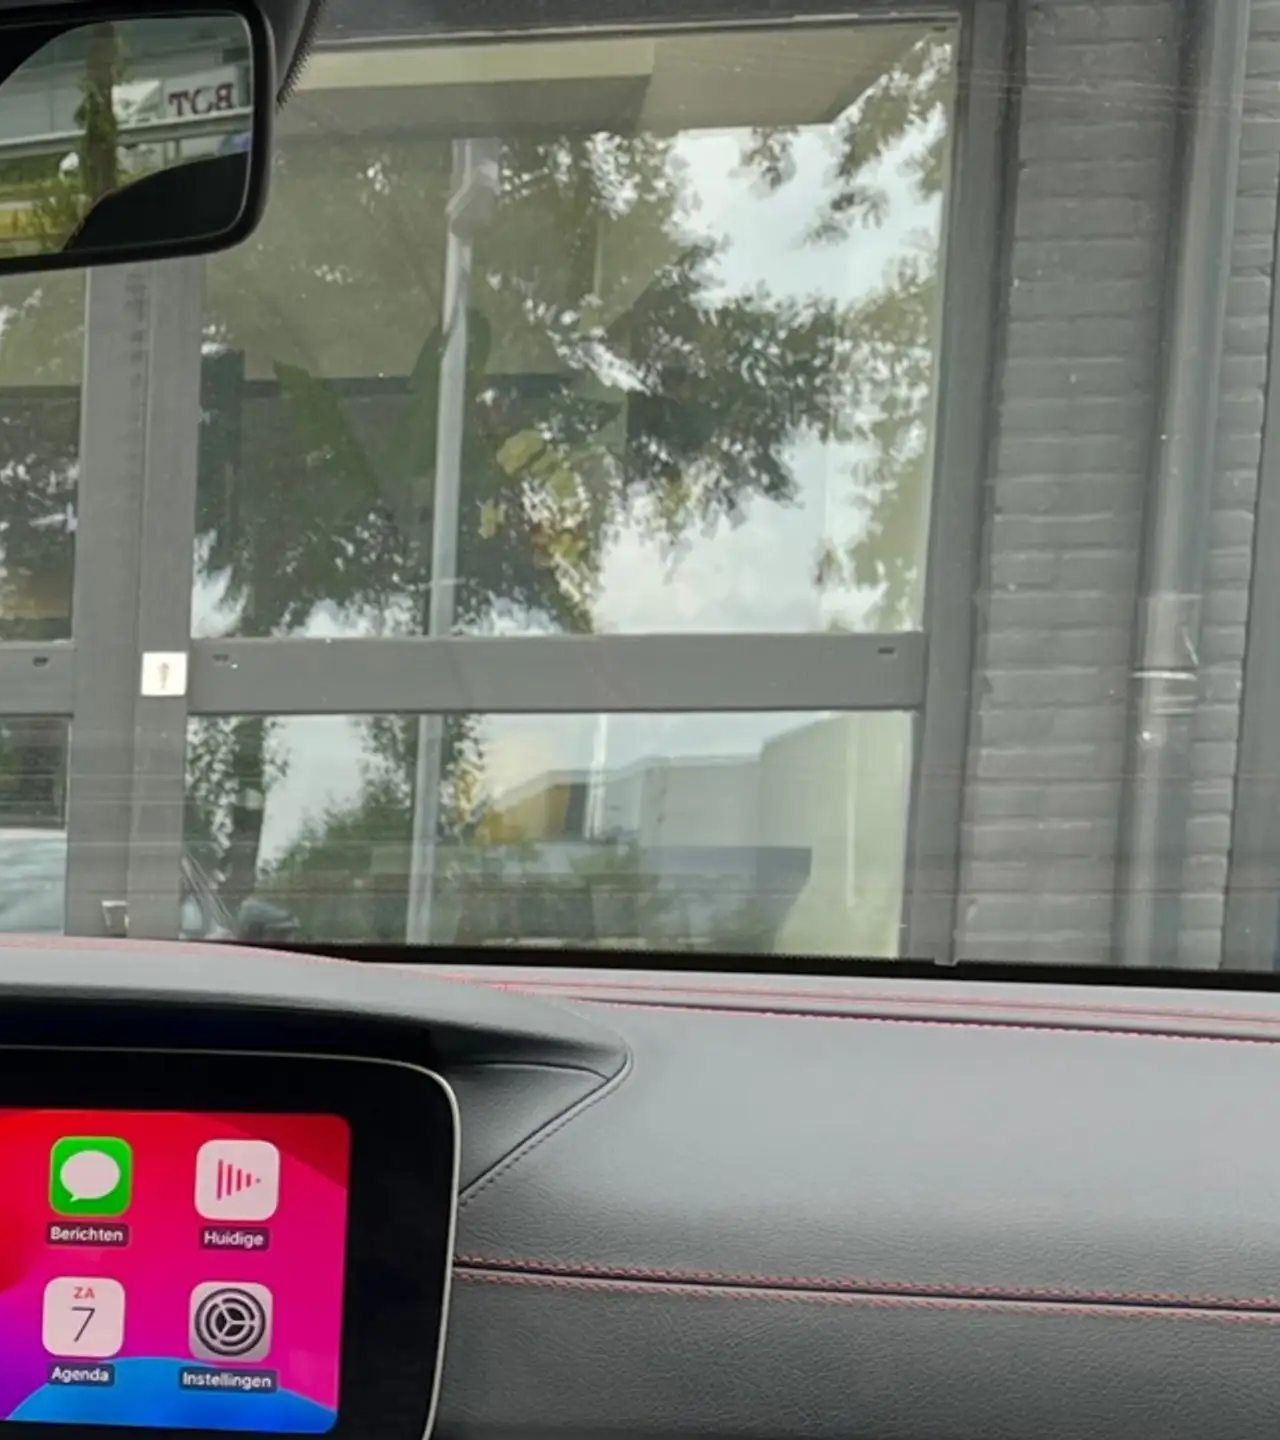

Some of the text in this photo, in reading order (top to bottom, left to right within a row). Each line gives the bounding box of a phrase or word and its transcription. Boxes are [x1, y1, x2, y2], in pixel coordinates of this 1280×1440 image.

[51, 1226, 124, 1243] Berichten
[204, 1230, 264, 1248] Huidige
[73, 1286, 96, 1300] ZA
[71, 1306, 97, 1343] 7
[51, 1366, 110, 1384] Agenda
[183, 1372, 273, 1390] Instellingen
